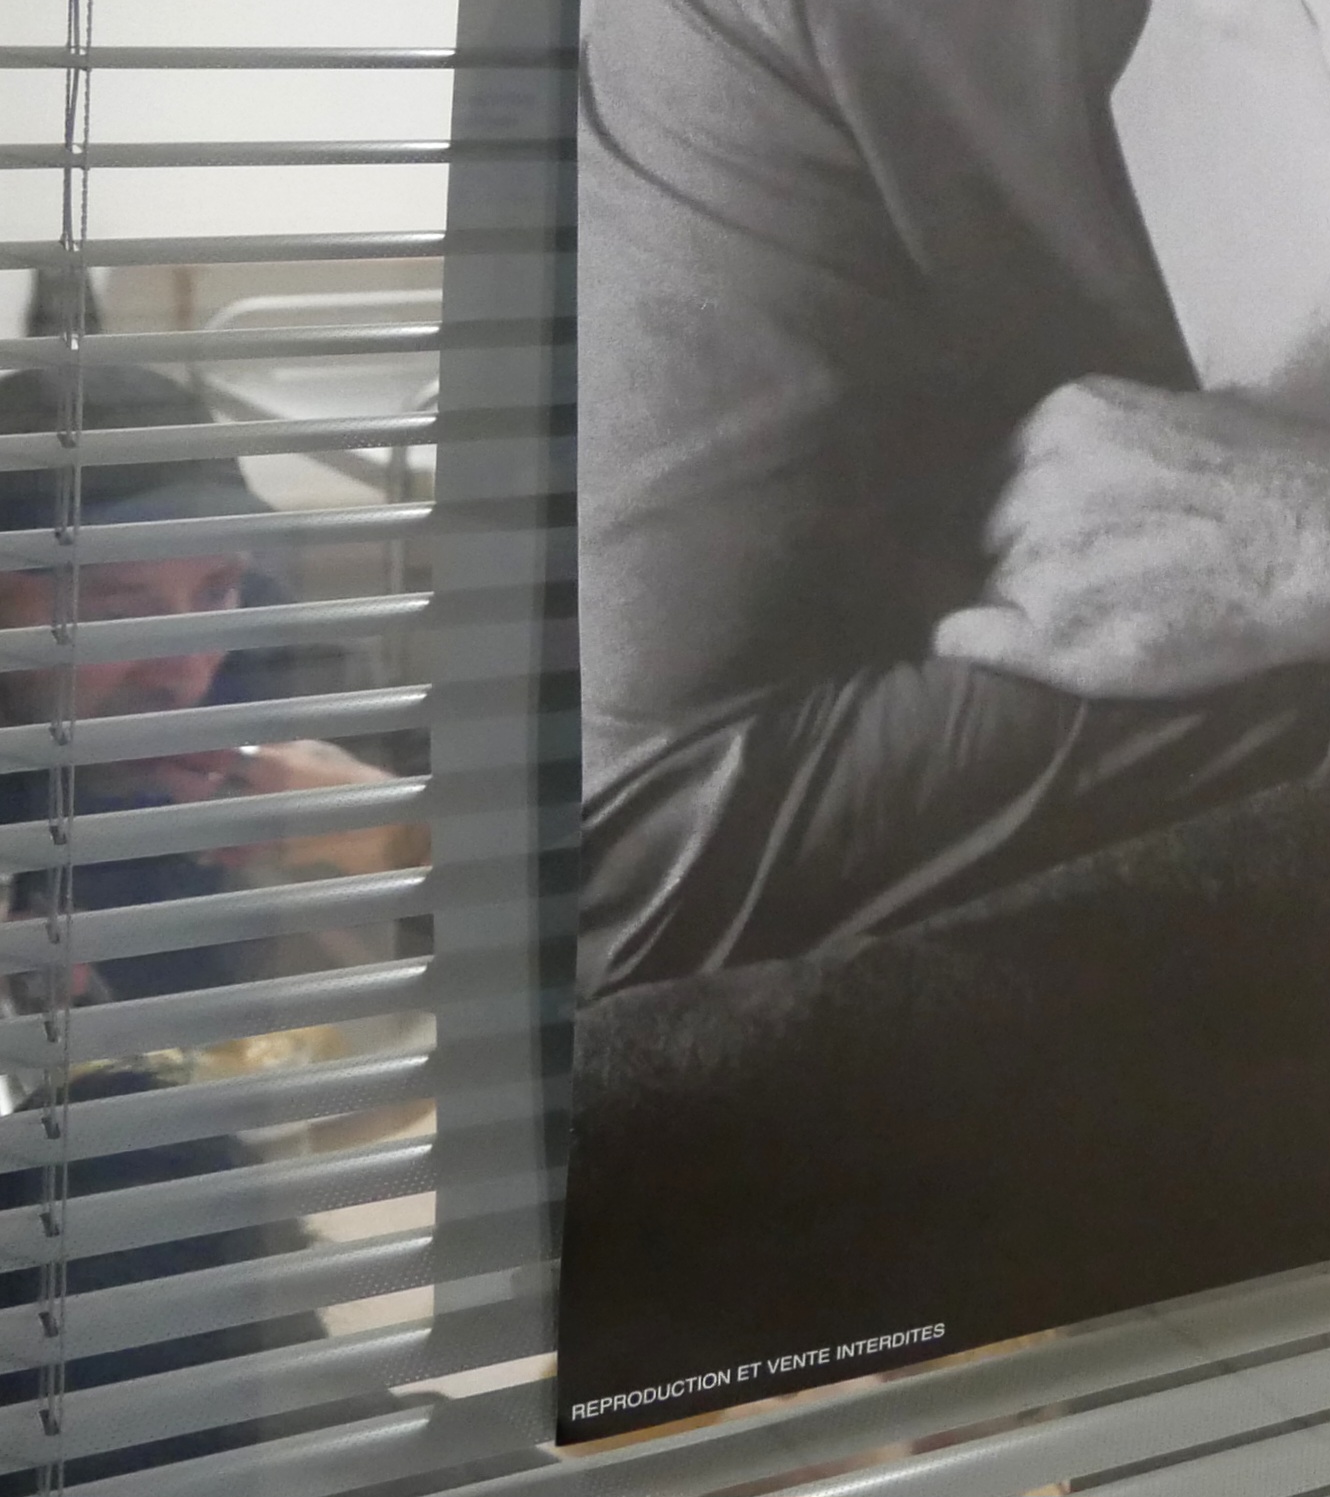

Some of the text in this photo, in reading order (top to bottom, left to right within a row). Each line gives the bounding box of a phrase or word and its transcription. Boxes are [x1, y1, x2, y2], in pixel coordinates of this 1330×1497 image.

[571, 1323, 946, 1421] REPRODUCTION ET VENTE INTERDITES
